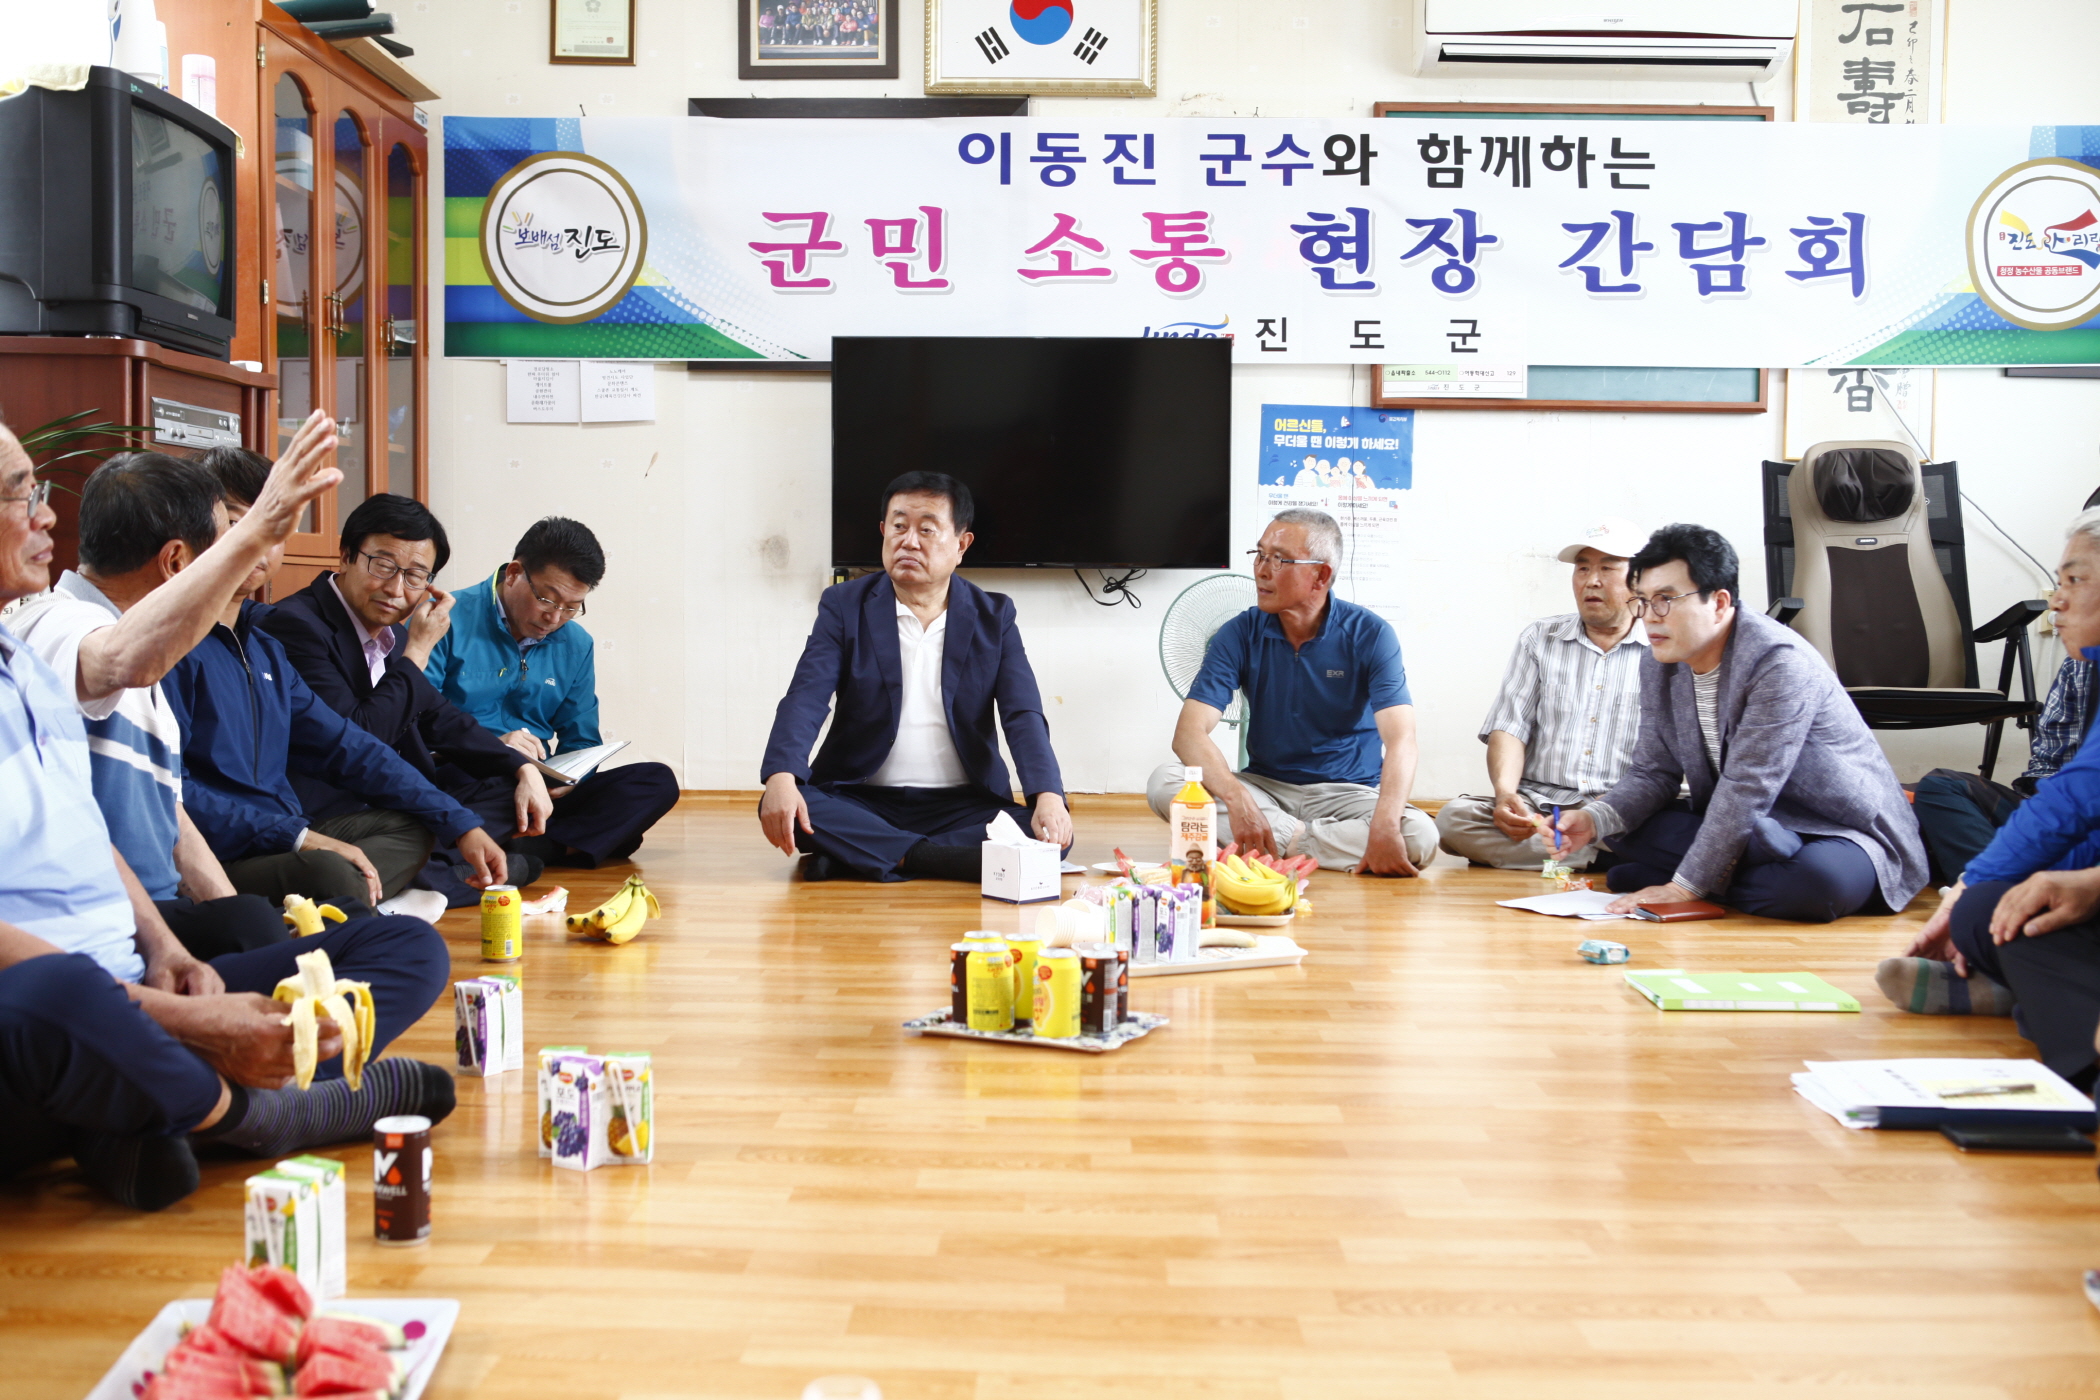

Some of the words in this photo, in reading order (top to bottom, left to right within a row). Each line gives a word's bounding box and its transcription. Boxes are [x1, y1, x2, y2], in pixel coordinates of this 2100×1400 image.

[958, 132, 1157, 188] 이동진
[1199, 133, 1378, 187] 군수와
[1417, 132, 1656, 190] 함께하는
[514, 227, 560, 251] 보배섬
[564, 225, 621, 259] 진도
[748, 205, 952, 291] 군민
[1017, 210, 1230, 296] 소통
[1290, 207, 1501, 297] 현장
[1558, 210, 1868, 300] 간담회
[1999, 266, 2014, 275] 청정
[2015, 266, 2042, 275] 농수산물
[2044, 266, 2080, 275] 공동브랜드
[1274, 418, 1328, 434] 어르신들,
[1273, 434, 1308, 448] 무더울
[1310, 436, 1323, 448] 땐
[1324, 436, 1359, 449] 이렇게
[1361, 437, 1400, 450] 하세요!
[1326, 669, 1345, 678] EXR
[1181, 821, 1209, 833] 탐라는
